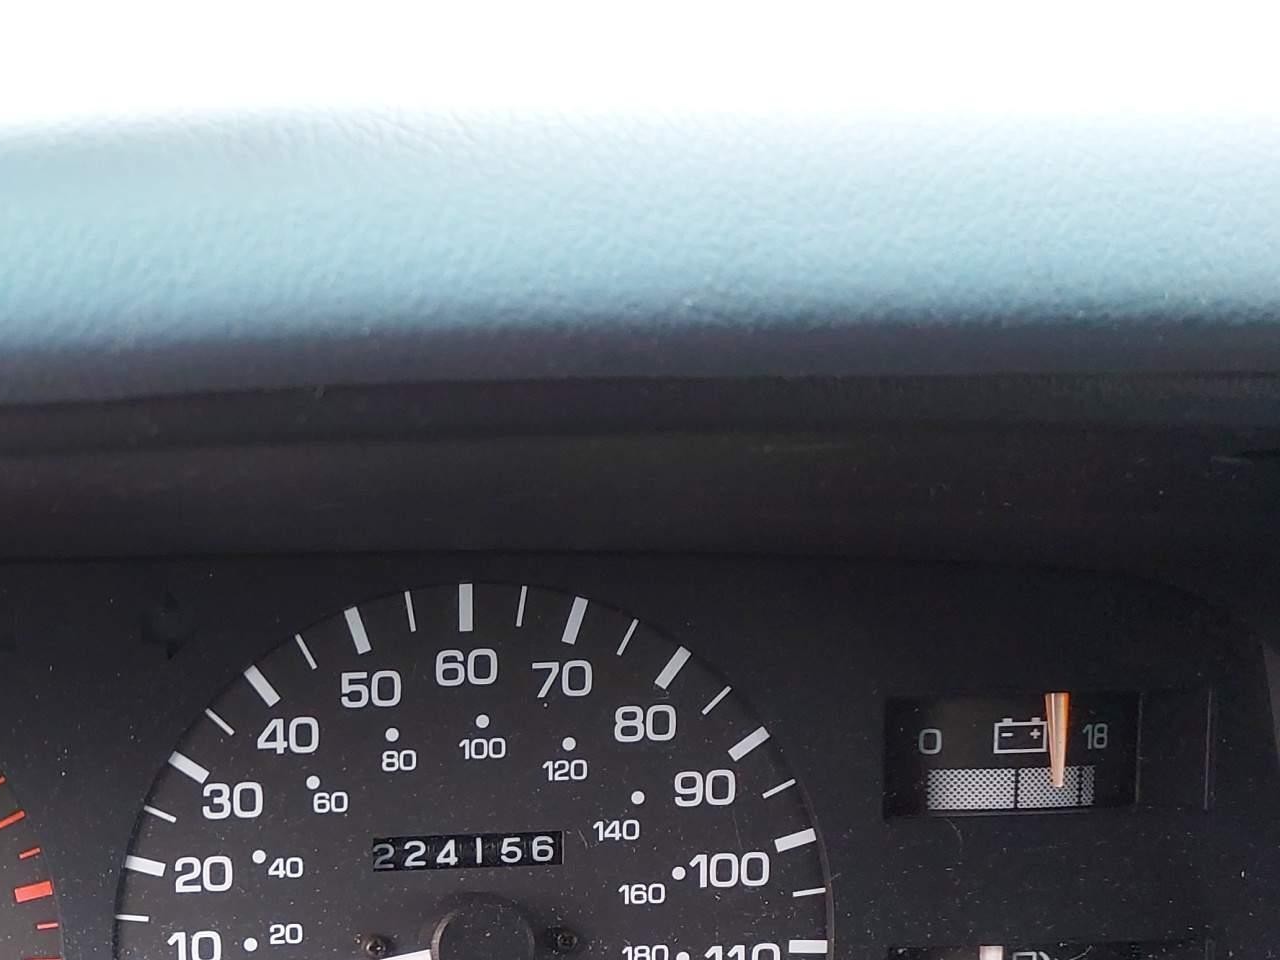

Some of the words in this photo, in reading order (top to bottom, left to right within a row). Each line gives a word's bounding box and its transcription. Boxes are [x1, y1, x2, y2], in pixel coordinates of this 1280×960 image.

[436, 649, 497, 686] 60
[532, 660, 592, 697] 70
[342, 671, 401, 707] 50
[257, 717, 319, 754] 40
[615, 705, 676, 742] 80
[1083, 724, 1107, 749] 18
[382, 750, 416, 771] 80
[459, 738, 505, 759] 100
[543, 760, 587, 780] 120
[202, 782, 263, 820] 30
[313, 792, 349, 813] 60
[675, 770, 735, 806] 90
[593, 820, 639, 841] 140
[268, 857, 304, 879] 40
[373, 835, 554, 868] 224156
[175, 856, 232, 892] 20
[690, 852, 769, 888] 100
[619, 884, 665, 904] 160
[270, 924, 302, 944] 20
